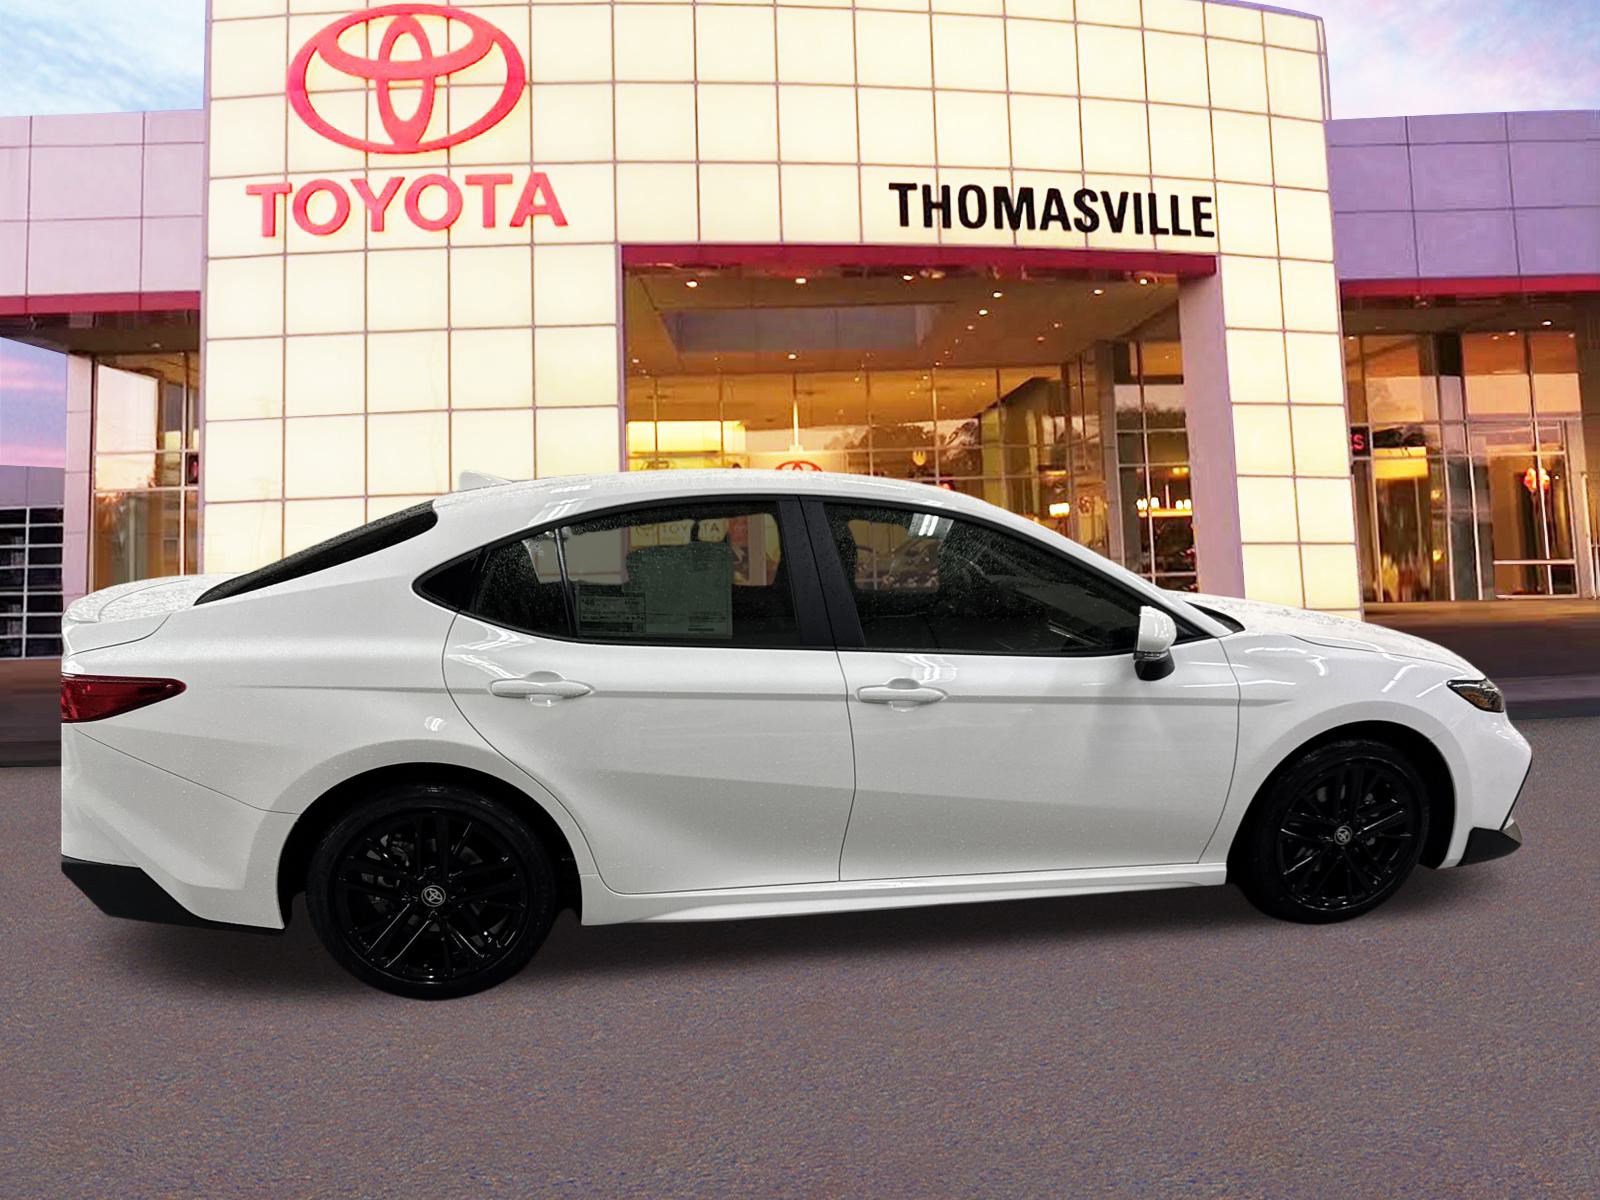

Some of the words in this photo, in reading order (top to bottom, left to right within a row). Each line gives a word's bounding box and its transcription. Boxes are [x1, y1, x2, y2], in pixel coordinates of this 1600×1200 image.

[246, 172, 567, 237] TOYOTA
[889, 183, 1215, 237] THOMASVILLE
[1351, 434, 1364, 450] S
[661, 522, 720, 533] TOYTA
